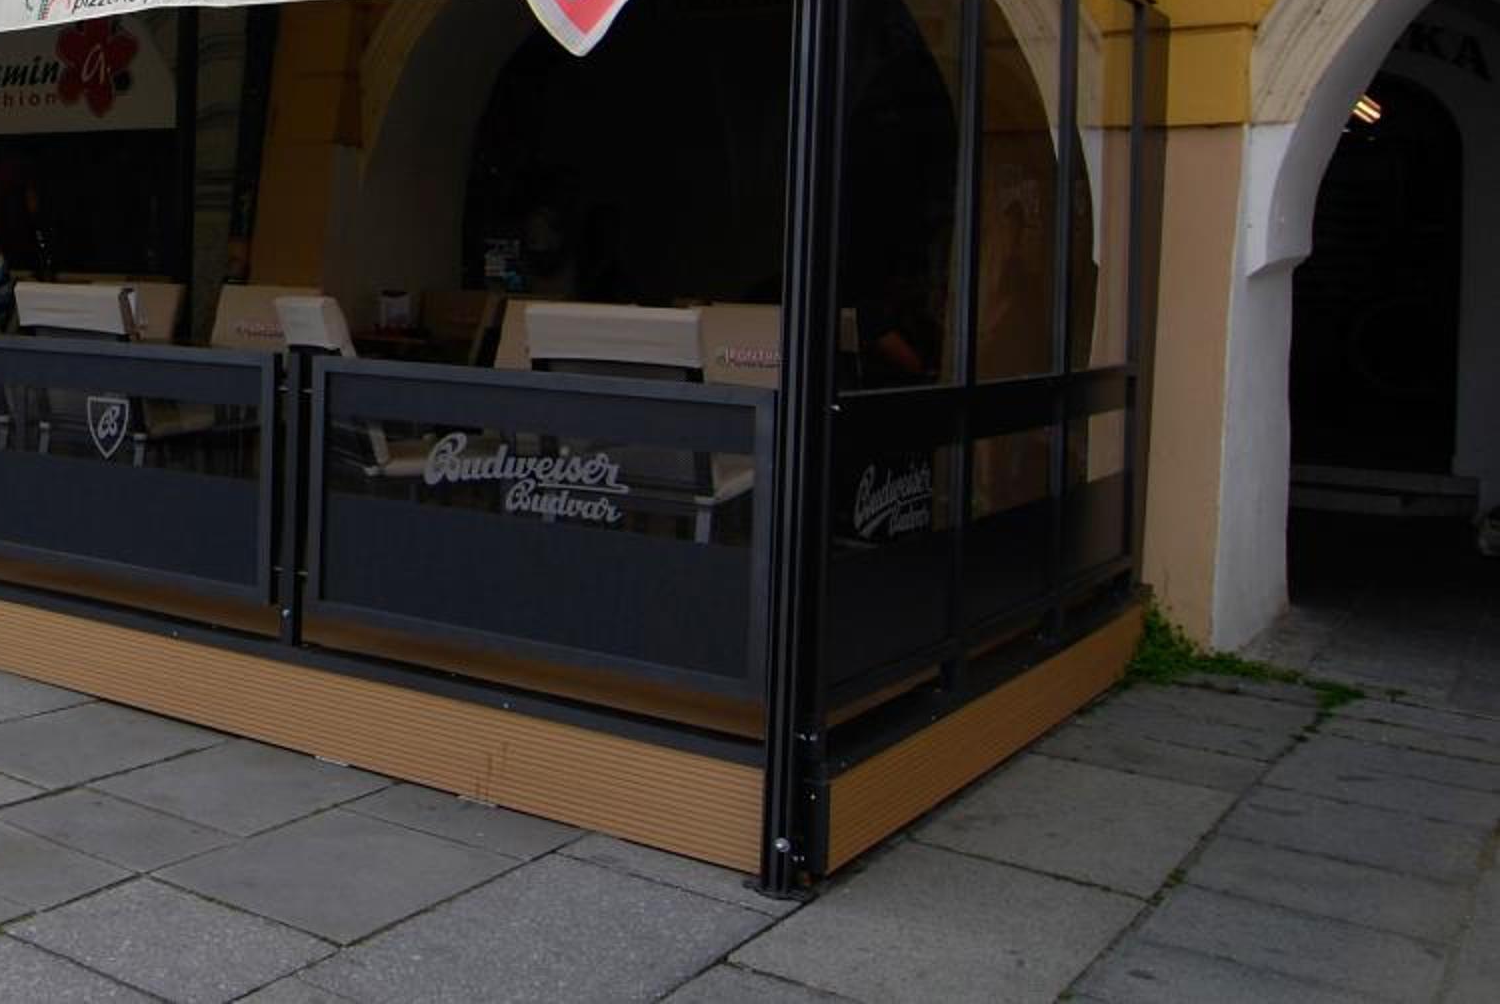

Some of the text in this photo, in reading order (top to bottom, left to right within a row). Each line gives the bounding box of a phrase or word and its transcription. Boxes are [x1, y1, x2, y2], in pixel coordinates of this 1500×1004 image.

[422, 431, 630, 495] Budweiser
[504, 478, 623, 523] Budvar
[852, 455, 933, 538] Budweiser
